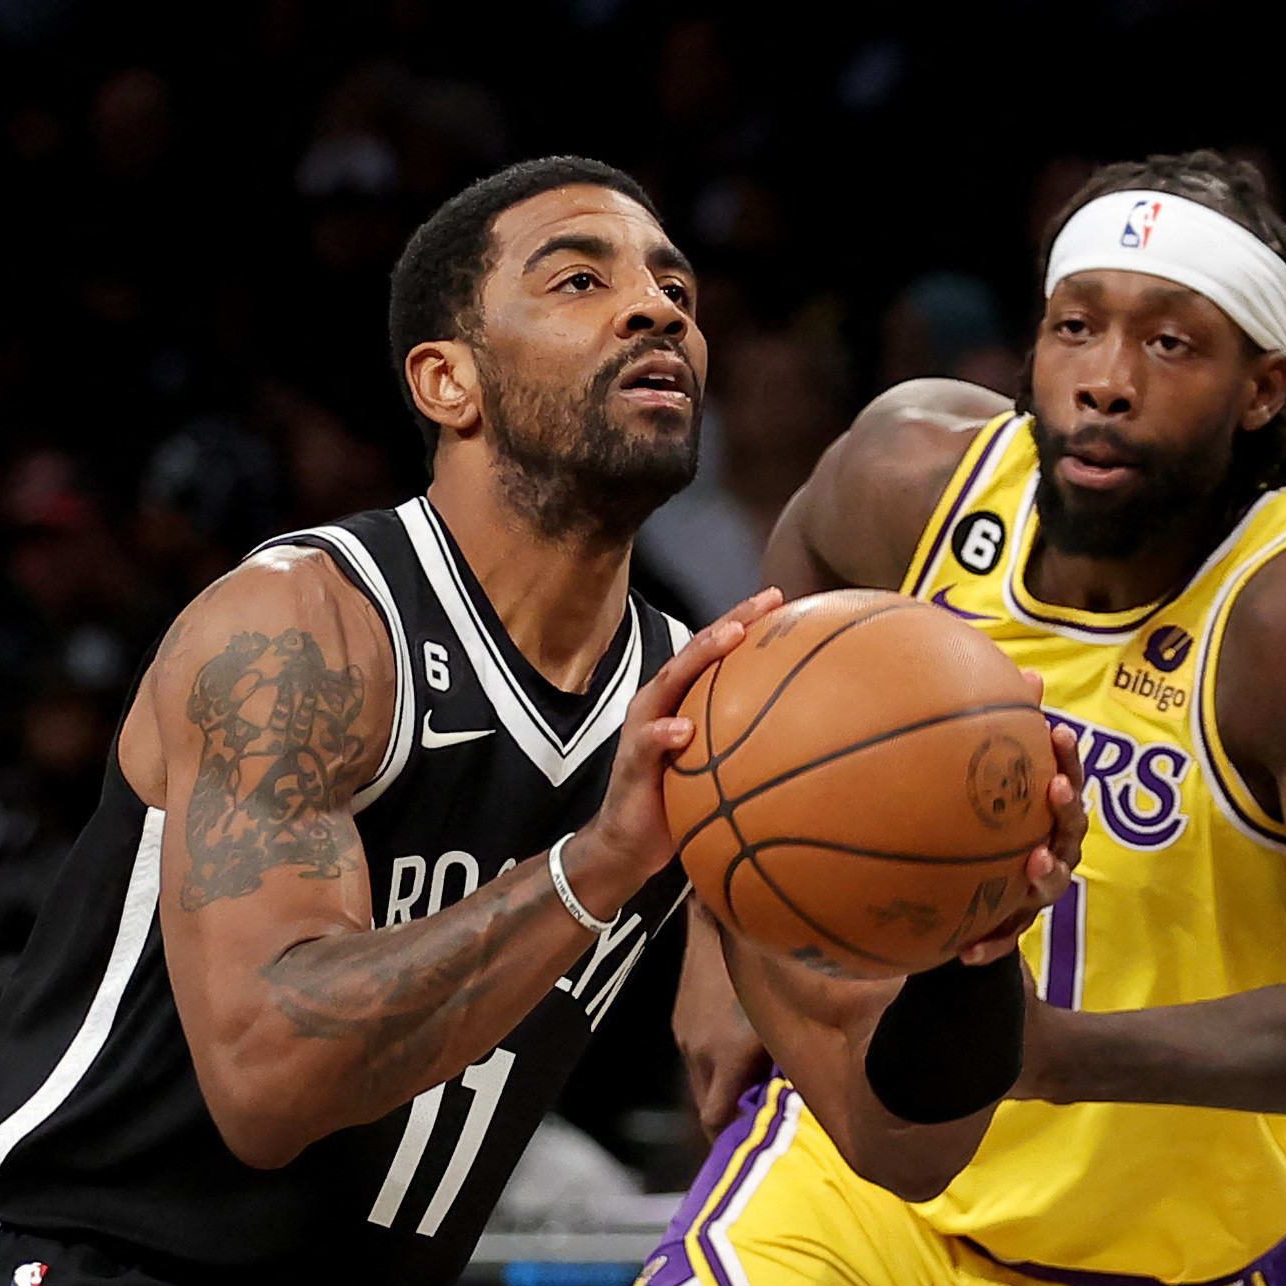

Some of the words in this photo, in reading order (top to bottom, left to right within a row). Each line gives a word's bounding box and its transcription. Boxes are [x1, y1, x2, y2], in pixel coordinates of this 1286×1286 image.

[959, 524, 1004, 572] 6
[423, 640, 451, 692] 6
[1113, 661, 1186, 712] bibigo
[367, 1047, 517, 1239] 11
